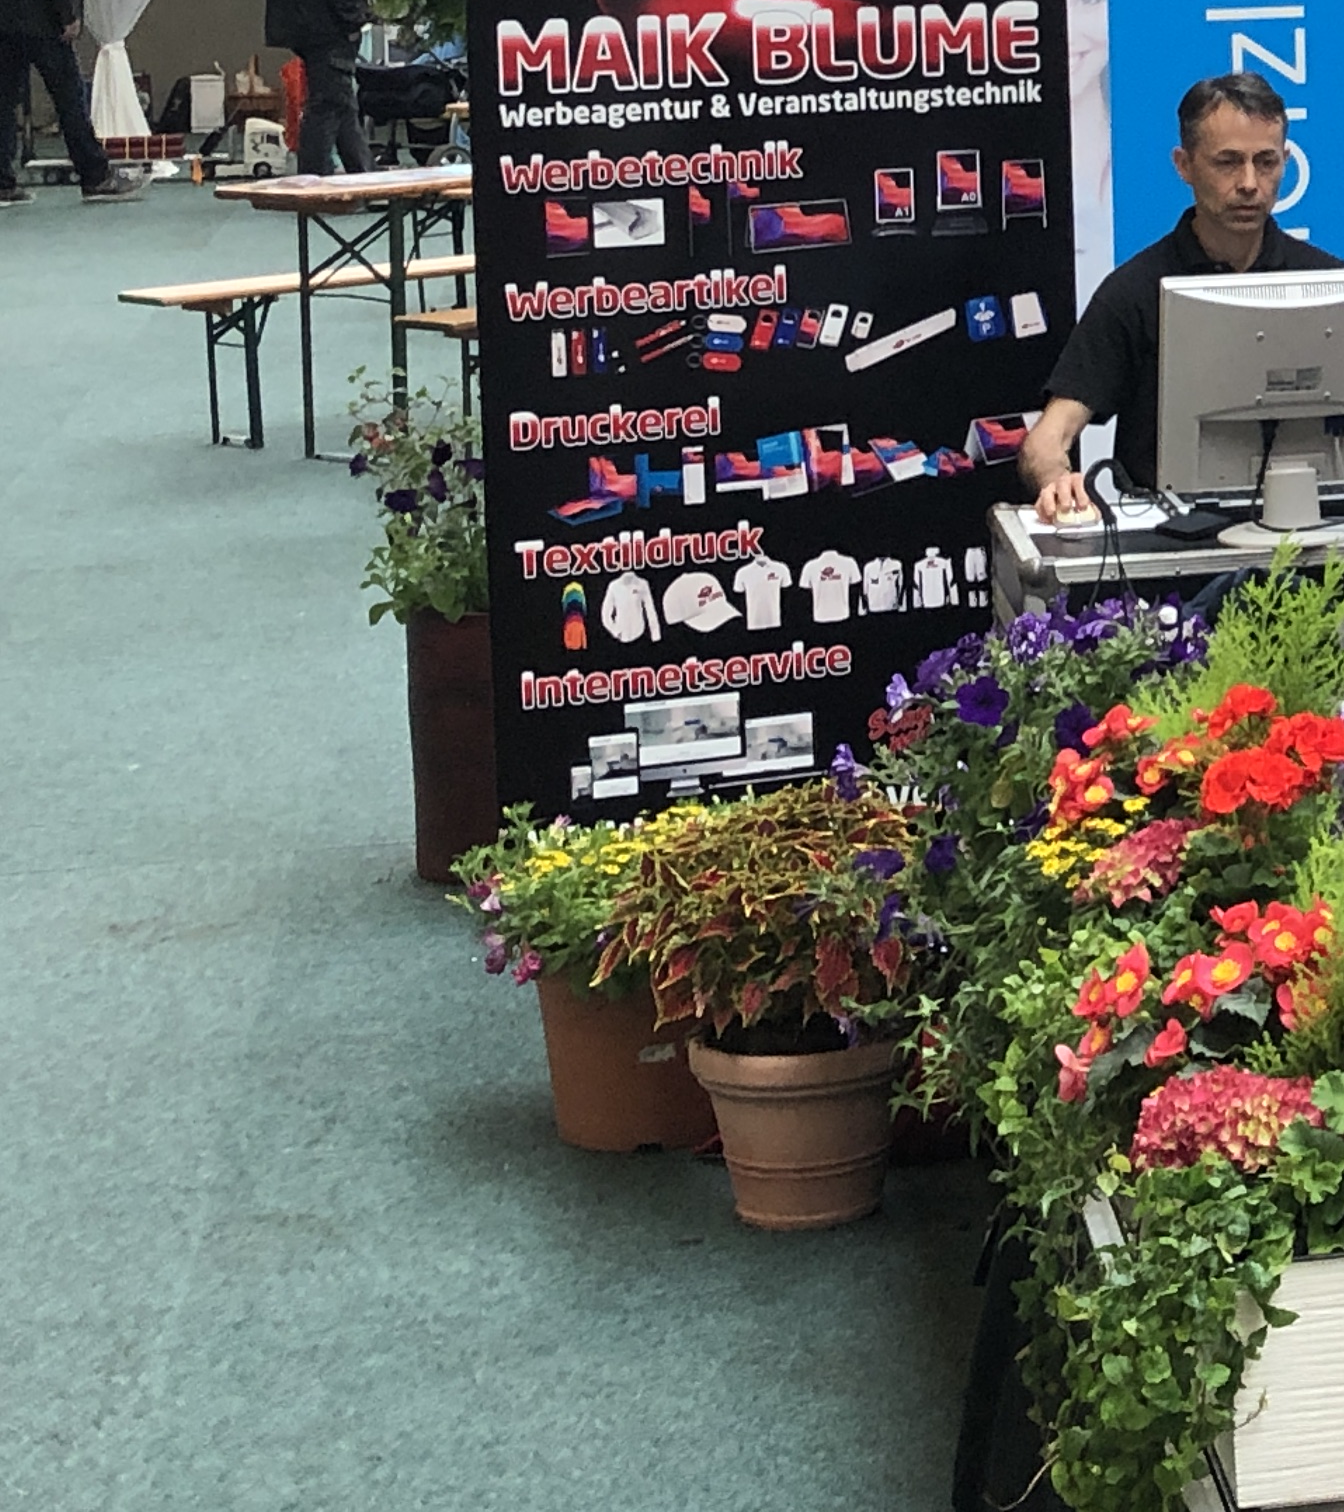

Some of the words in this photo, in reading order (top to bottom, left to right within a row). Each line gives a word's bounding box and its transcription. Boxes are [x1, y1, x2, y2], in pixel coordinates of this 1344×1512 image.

[496, 11, 729, 96] MAIK
[752, 0, 1041, 86] BLUME
[498, 97, 703, 129] Werbeagentur
[710, 94, 732, 119] &
[738, 80, 1042, 117] Veranstaltungstechnik
[501, 140, 804, 194] Werbetechnik
[505, 264, 788, 322] Werbeartikel
[509, 396, 722, 451] Druckerei
[515, 520, 764, 578] Textildruck
[520, 641, 852, 711] Internetservice
